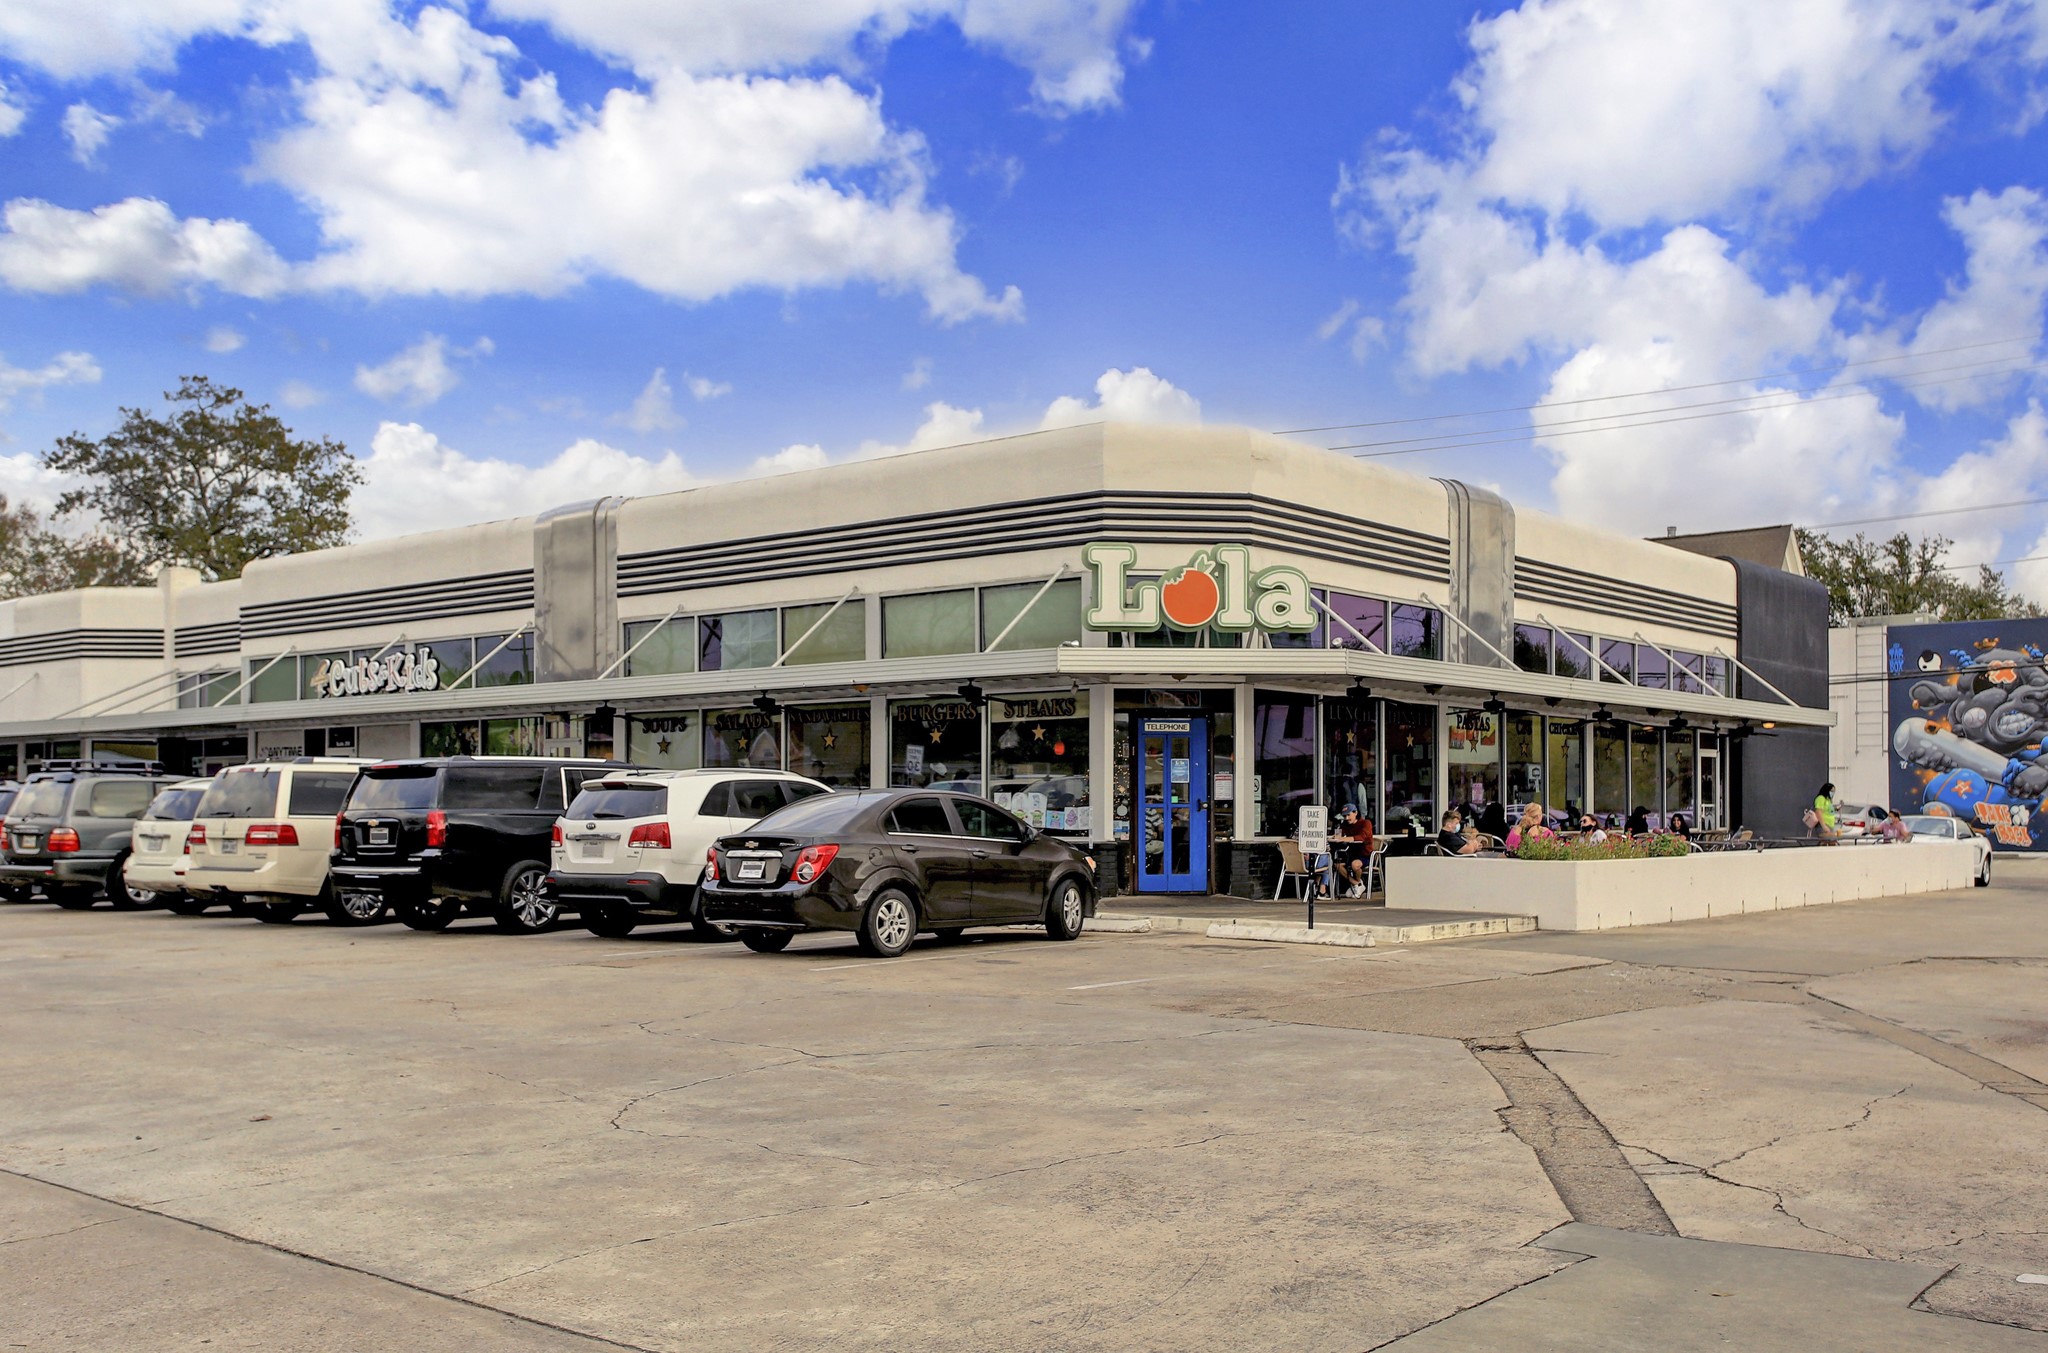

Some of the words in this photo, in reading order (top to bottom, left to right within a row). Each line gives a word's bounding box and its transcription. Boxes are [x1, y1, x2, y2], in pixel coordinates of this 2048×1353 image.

[1082, 542, 1318, 633] Lola
[329, 657, 380, 698] Cuts
[384, 647, 440, 694] Kids
[896, 702, 977, 722] BURGERS
[1004, 697, 1076, 719] STEAKS
[642, 716, 688, 734] SOUPS
[715, 712, 771, 731] SALADS
[1146, 723, 1188, 731] TELEPHONE
[1456, 713, 1491, 732] PASTAS
[1307, 810, 1320, 819] TAKE
[1307, 820, 1318, 829] OUT
[1301, 830, 1324, 839] PARKING
[1305, 840, 1319, 849] ONLY
